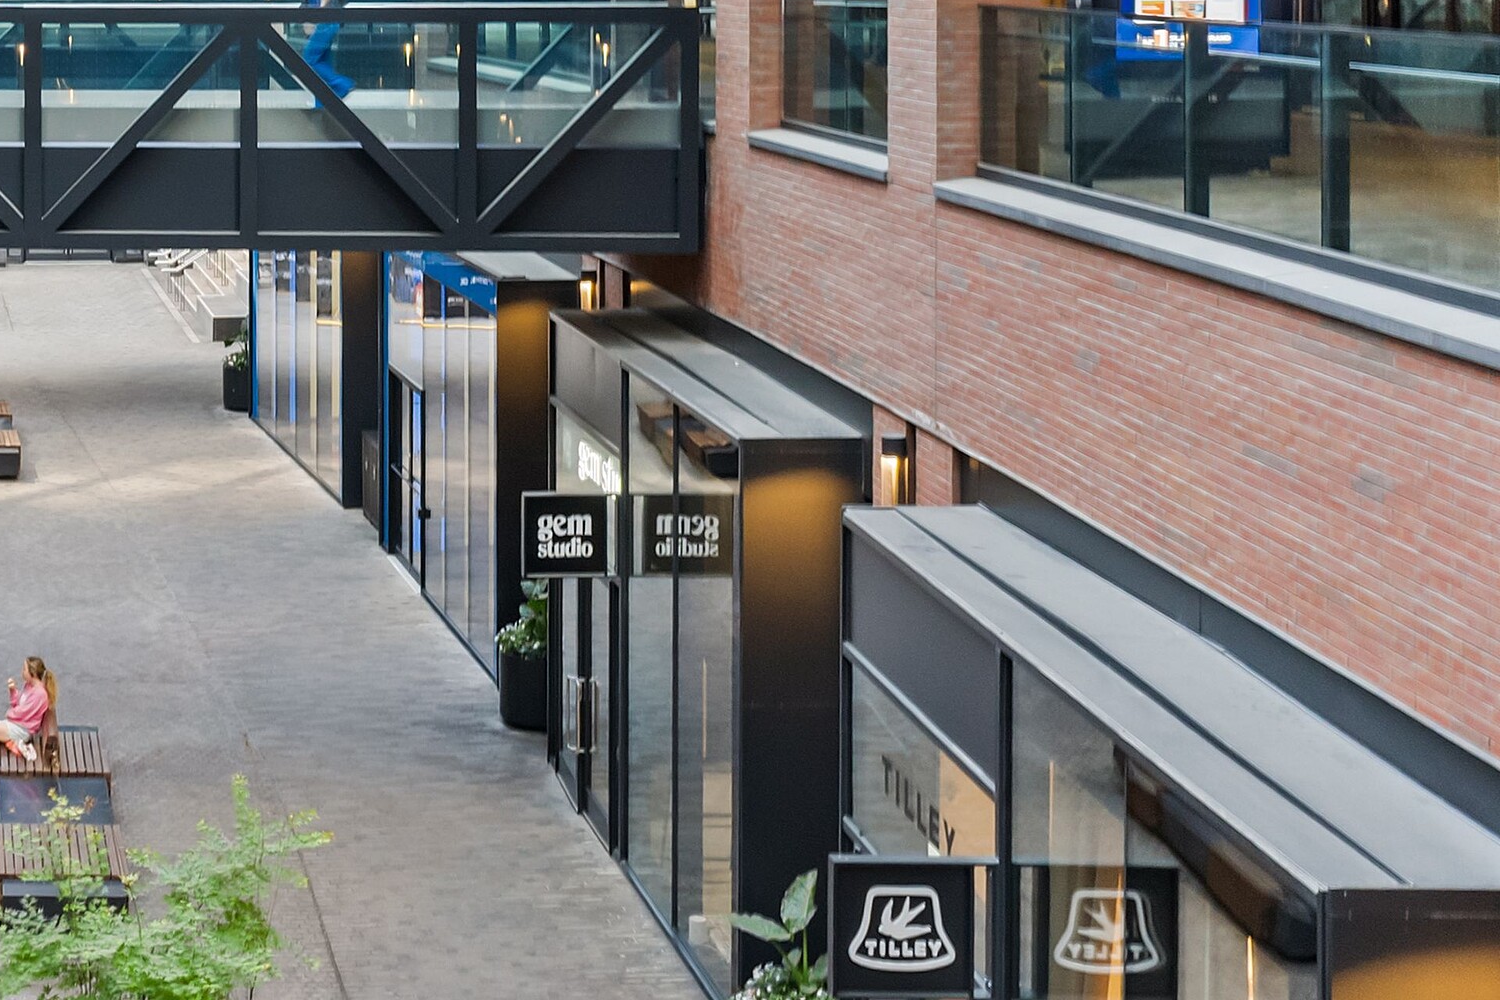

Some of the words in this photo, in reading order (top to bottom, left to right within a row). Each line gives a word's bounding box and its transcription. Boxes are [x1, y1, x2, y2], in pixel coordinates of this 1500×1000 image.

[537, 513, 592, 542] gem
[537, 536, 594, 559] studio
[881, 754, 956, 856] TILLEY
[864, 938, 943, 958] TILLEY
